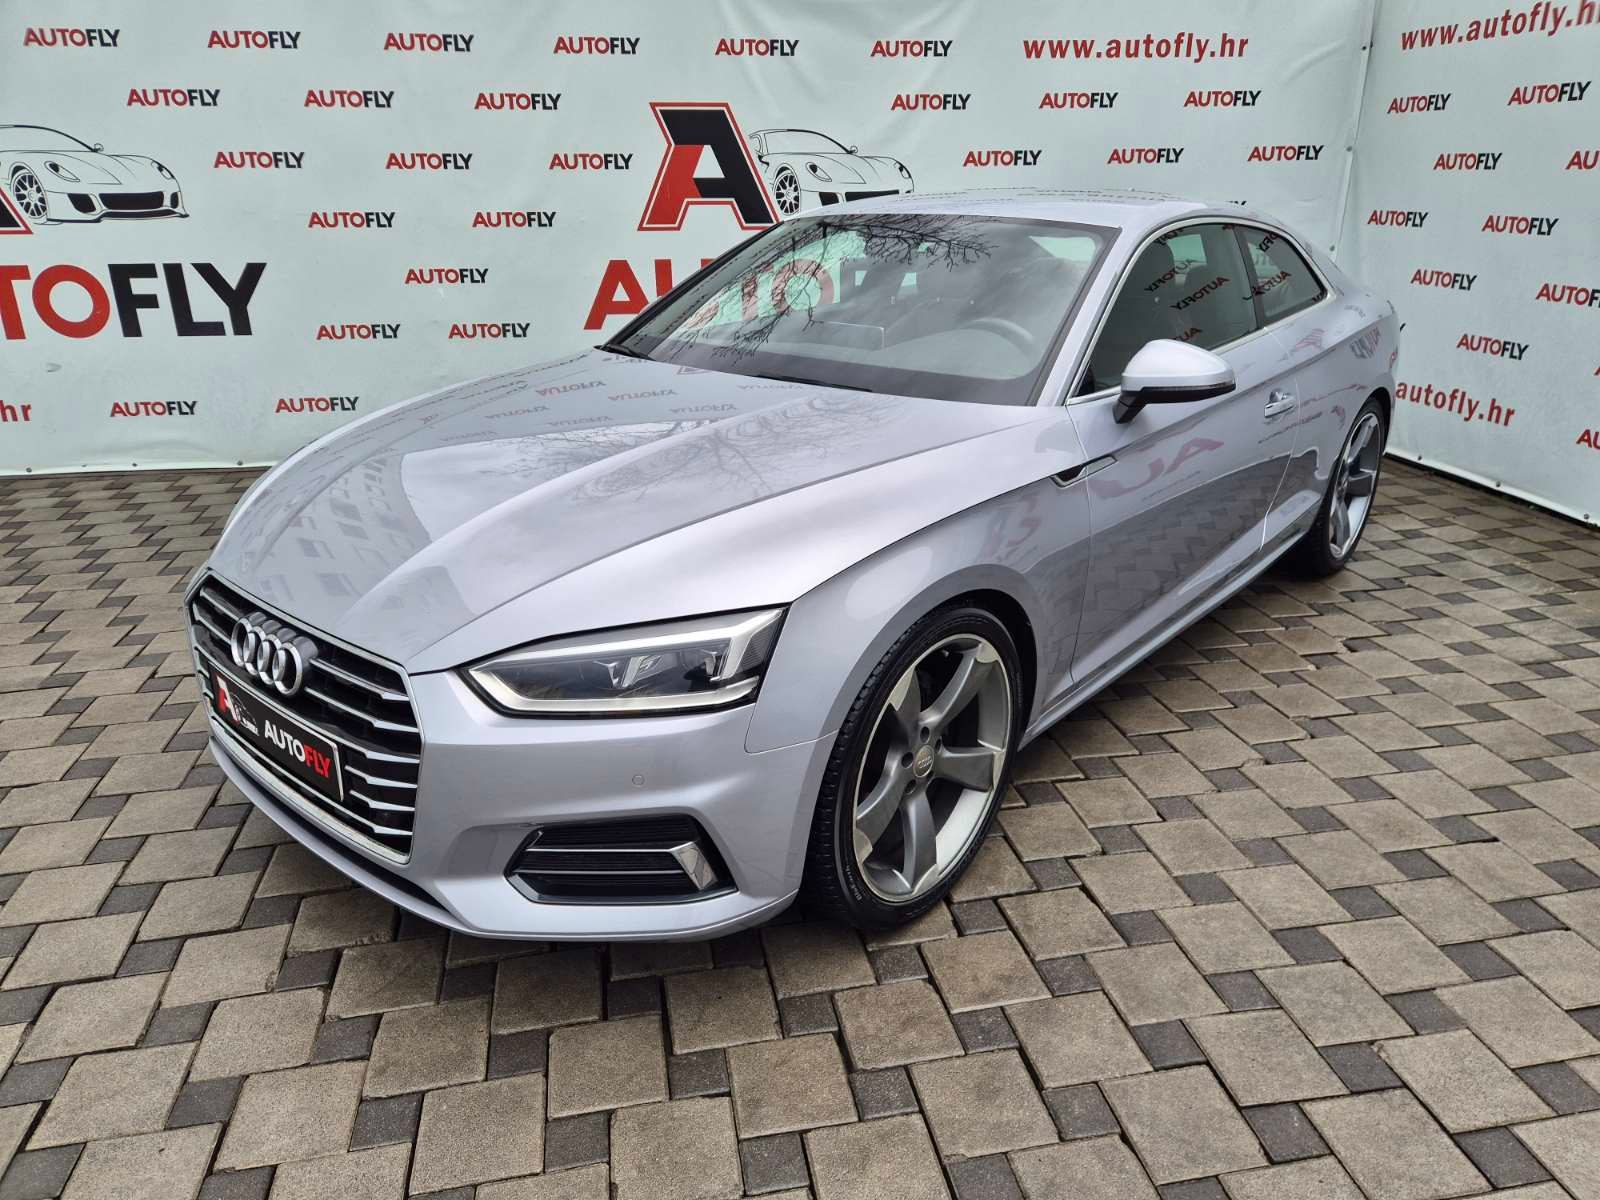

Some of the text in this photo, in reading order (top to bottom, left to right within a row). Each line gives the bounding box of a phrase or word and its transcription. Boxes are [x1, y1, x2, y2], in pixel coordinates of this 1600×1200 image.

[1401, 0, 1600, 50] www.autofly.h
[23, 28, 120, 48] AUTOFLY
[207, 30, 301, 49] AUTOFLY
[384, 33, 475, 52] AUTOFLY
[553, 36, 640, 55] AUTOFLY
[715, 38, 799, 57] AUTOFLY
[870, 40, 954, 58] AUTOFLY
[1023, 32, 1248, 63] www.autofly.hr
[127, 89, 220, 107] AUTOFLY
[304, 90, 394, 108] AUTOFLY
[474, 92, 562, 111] AUTOFLY
[891, 93, 971, 111] AUTOFLY
[1039, 92, 1119, 109] AUTOFLY
[1184, 90, 1262, 108] AUTOFLY
[1507, 81, 1592, 106] AUTOFLY
[1387, 93, 1451, 114] AUTOFLY
[213, 151, 305, 169] AUTOFLY
[385, 153, 473, 171] AUTOFLY
[549, 153, 633, 171] AUTOFLY
[963, 149, 1042, 167] AUTOFLY
[1107, 147, 1184, 165] AUTOFLY
[1247, 145, 1325, 163] AUTOFLY
[1433, 152, 1503, 170] AUTOFLY
[308, 212, 395, 229] AUTOFLY
[472, 212, 556, 228] AUTOFLY
[1367, 209, 1428, 229] AUTOFLY
[1481, 214, 1559, 236] AUTOFLY
[405, 267, 488, 285] AUTOFLY
[1410, 269, 1477, 291] AUTOFLY
[1536, 283, 1600, 308] AUTOF
[316, 323, 401, 340] AUTOFLY
[448, 323, 530, 340] AUTOFLY
[1456, 334, 1529, 360] AUTOFLY
[110, 400, 198, 418] AUTOFLY
[275, 396, 359, 414] AUTOFLY
[265, 720, 331, 777] AUTOFLY
